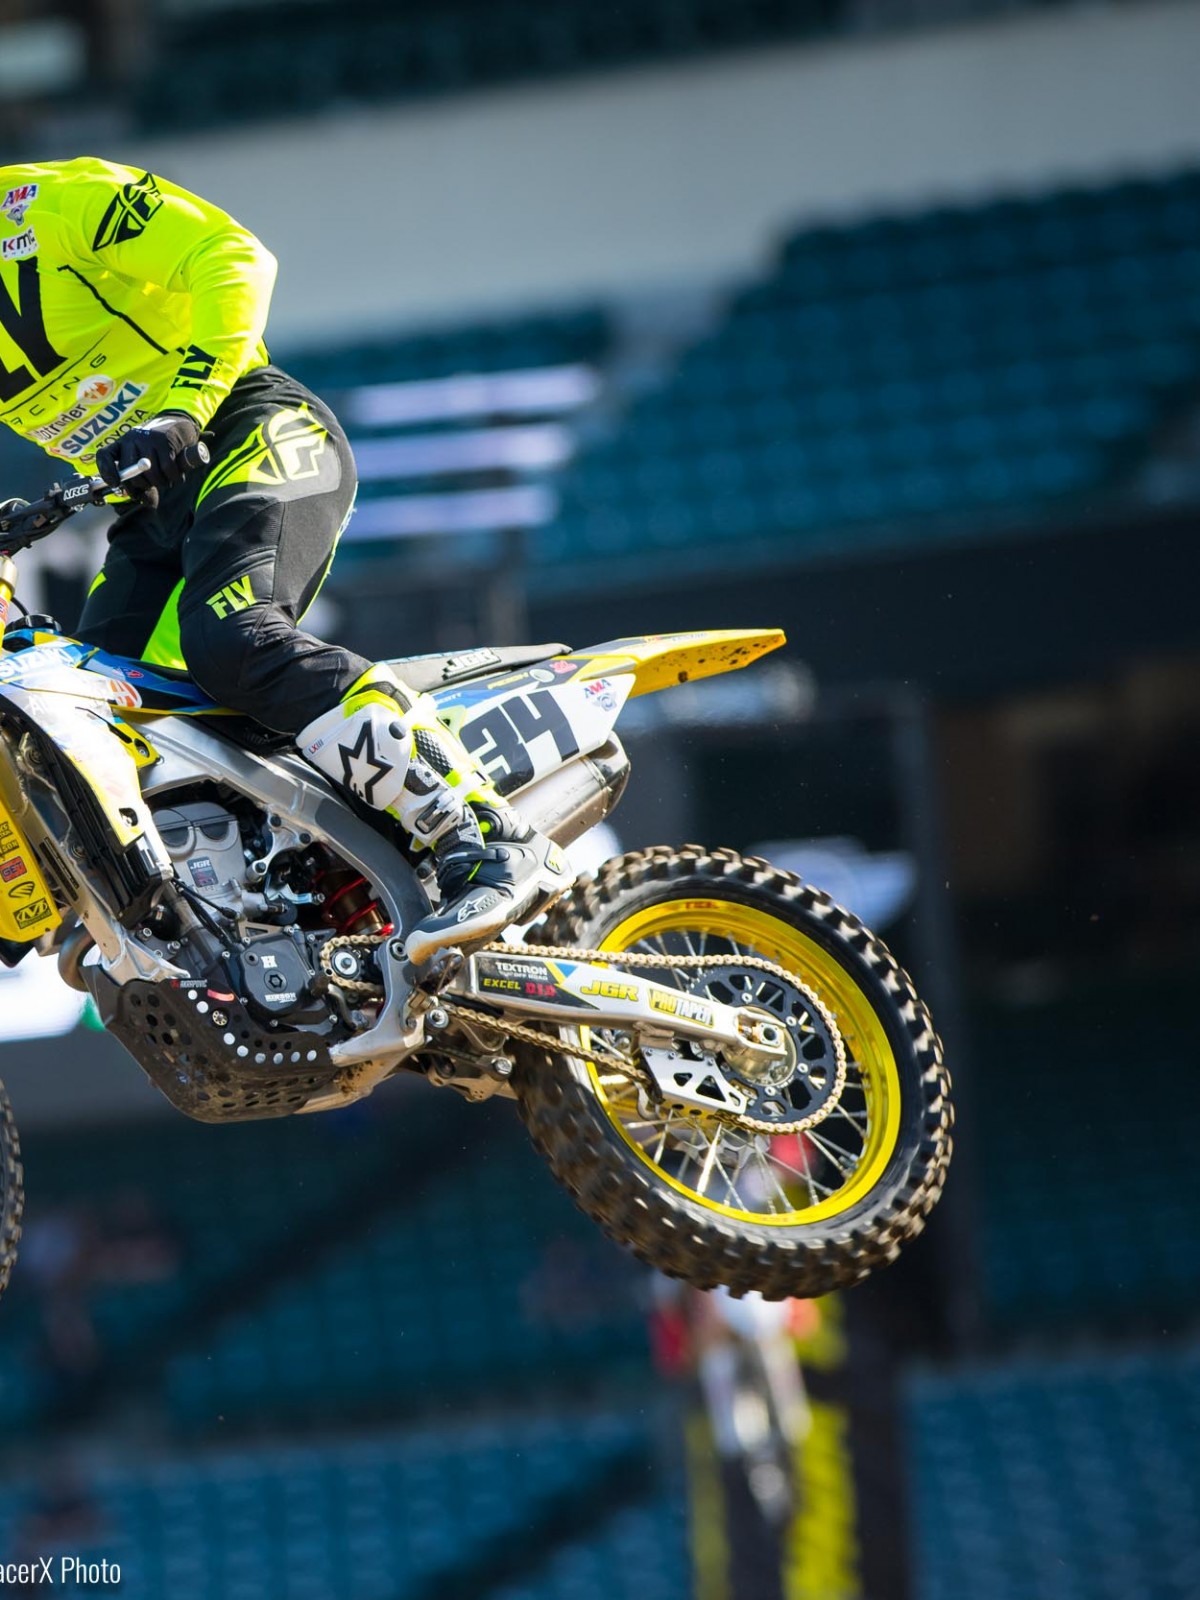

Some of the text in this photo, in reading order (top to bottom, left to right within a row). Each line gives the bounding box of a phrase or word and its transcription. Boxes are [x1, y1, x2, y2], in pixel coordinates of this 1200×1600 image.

[1, 184, 37, 208] AMA
[170, 344, 217, 392] FLY
[60, 382, 143, 455] SUZUKI
[205, 574, 257, 620] FLY
[443, 647, 501, 679] JGR
[459, 689, 581, 798] 34
[483, 978, 522, 990] EXCEL
[495, 961, 548, 976] TEXTRON
[580, 979, 639, 1001] JGR
